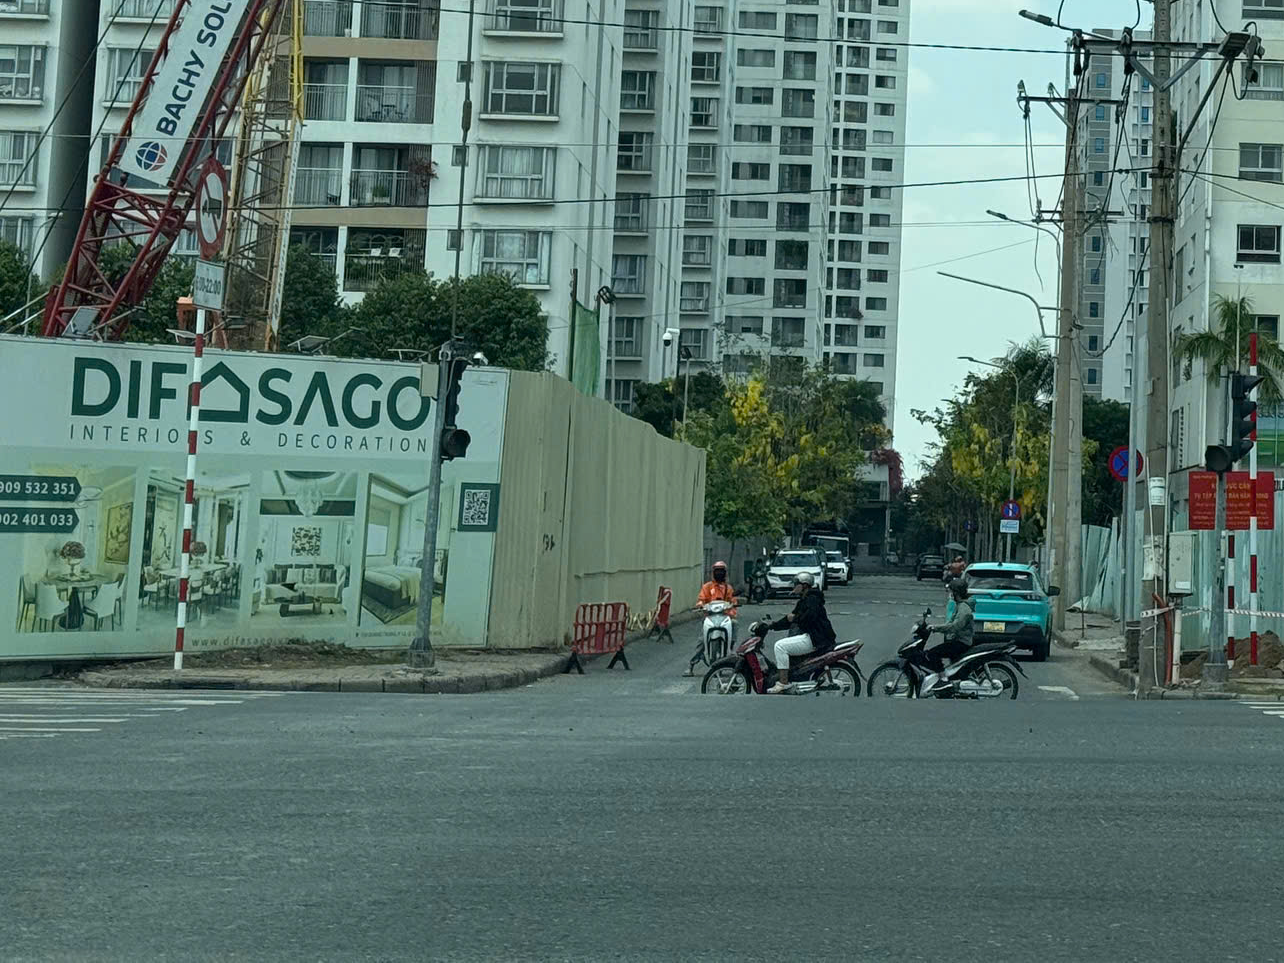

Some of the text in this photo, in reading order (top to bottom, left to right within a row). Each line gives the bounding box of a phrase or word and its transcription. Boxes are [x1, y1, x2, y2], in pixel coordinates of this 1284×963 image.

[156, 49, 205, 136] BACHY
[70, 424, 428, 453] INTERIOS & DECORATION
[25, 482, 49, 494] 532
[52, 483, 76, 495] 351
[0, 513, 73, 526] 02 401 033
